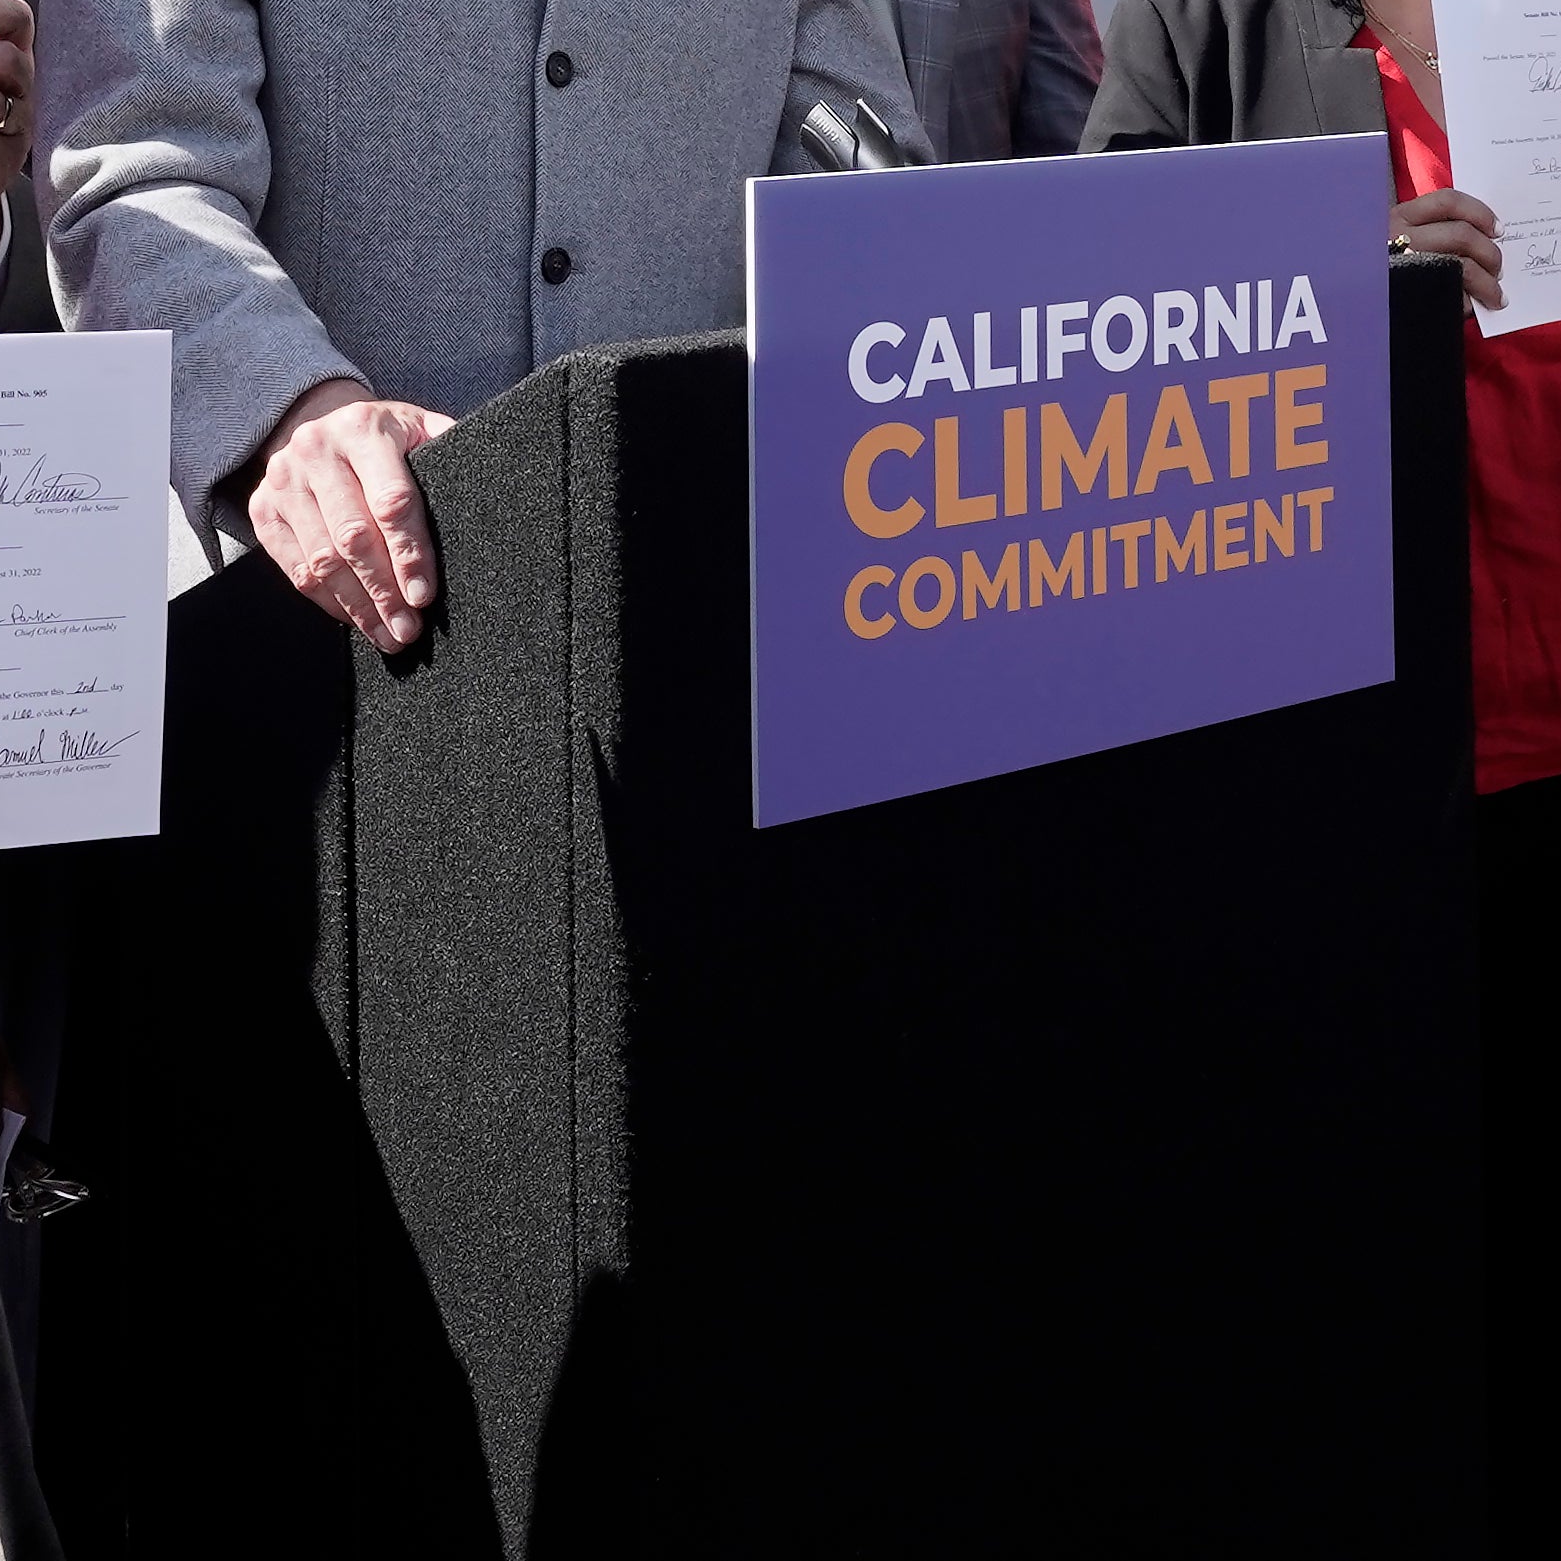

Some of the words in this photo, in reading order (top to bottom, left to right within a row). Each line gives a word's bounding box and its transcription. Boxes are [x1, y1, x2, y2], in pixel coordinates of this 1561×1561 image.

[848, 274, 1328, 403] CALIFORNIA
[1, 390, 15, 399] Bill
[17, 390, 31, 398] No.
[33, 389, 48, 398] 905
[12, 448, 31, 457] 2022
[843, 363, 1330, 540] CLIMATE
[34, 506, 69, 515] Secretary
[71, 505, 80, 514] of
[81, 504, 91, 513] the
[94, 504, 120, 512] Senate
[843, 486, 1334, 640] COMMITMENT
[8, 569, 21, 578] 31,
[22, 568, 42, 577] 2022
[14, 627, 37, 638] Chief
[37, 626, 58, 635] Clerk
[59, 625, 68, 635] of
[69, 624, 81, 633] the
[82, 622, 118, 633] Assembly
[0, 691, 11, 700] the
[13, 690, 49, 700] Governor
[50, 688, 64, 696] this
[110, 683, 124, 692] day
[62, 765, 74, 773] the
[76, 762, 112, 772] Governor
